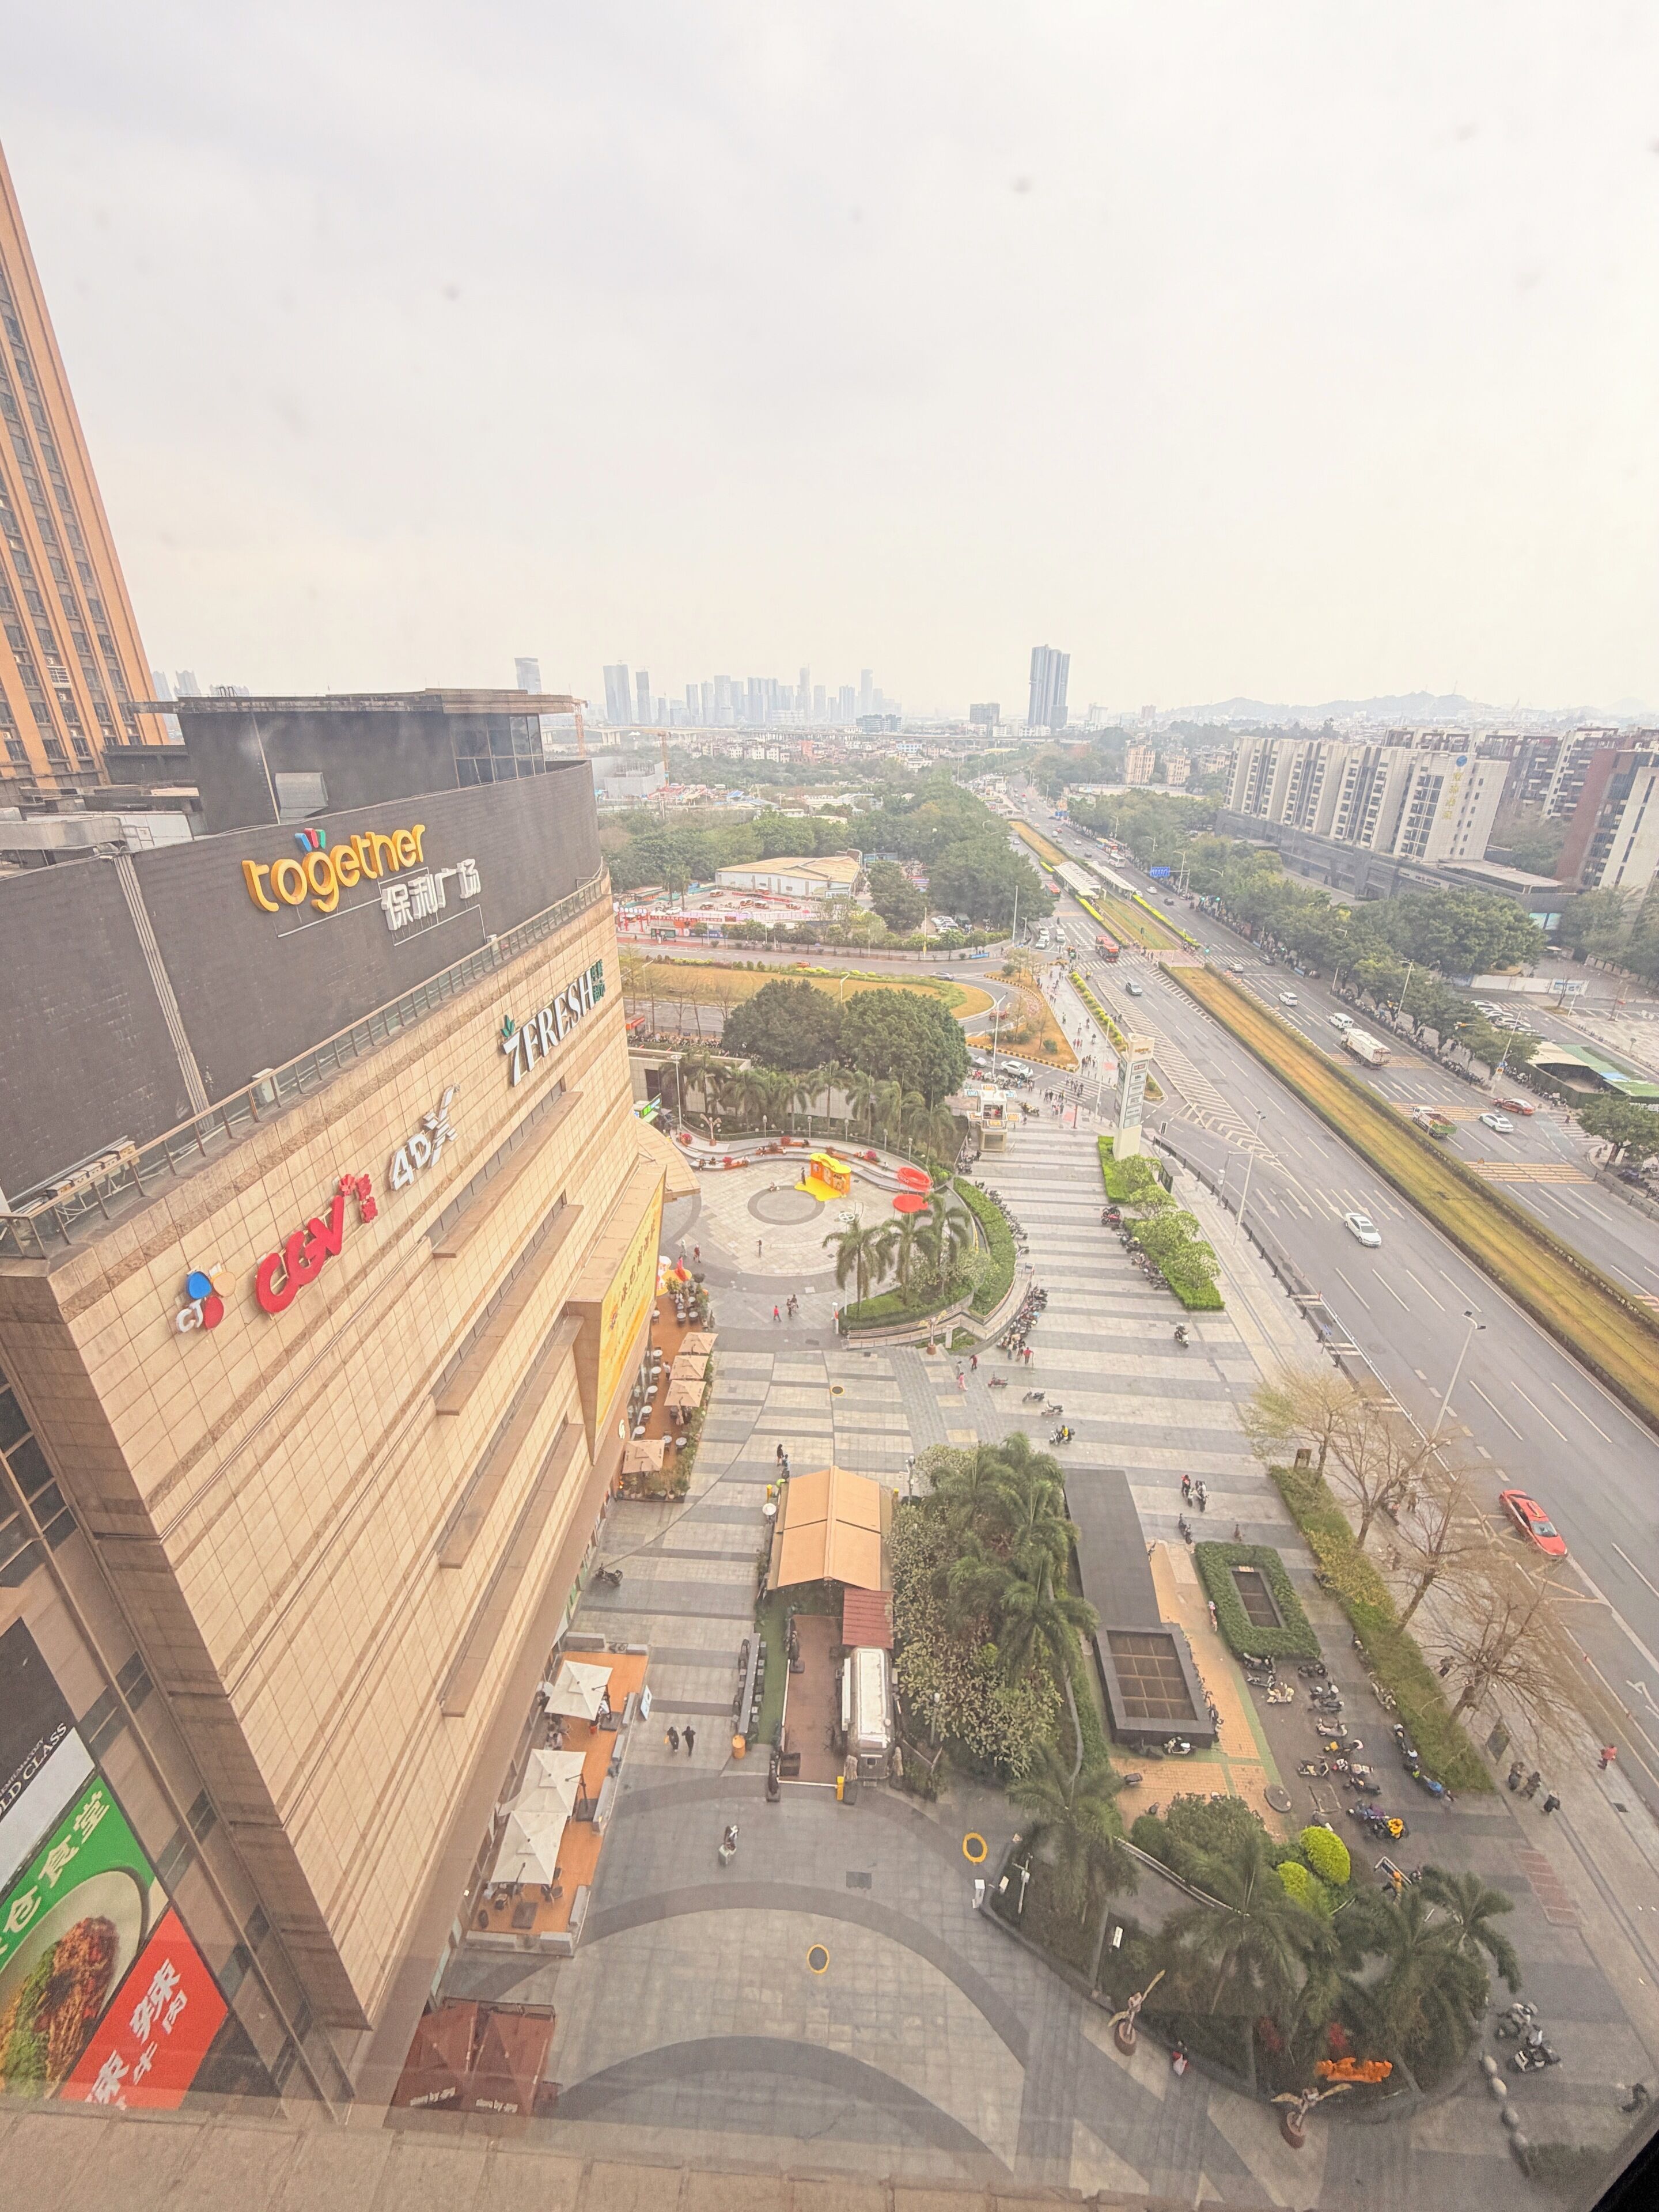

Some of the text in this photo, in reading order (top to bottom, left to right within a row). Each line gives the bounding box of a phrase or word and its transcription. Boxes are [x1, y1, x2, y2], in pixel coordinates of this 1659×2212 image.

[242, 824, 425, 912] together
[381, 858, 480, 930] 保利广场
[502, 967, 595, 1087] 7FRESH
[256, 1195, 344, 1313] CGV
[23, 1722, 66, 1780] CLASS
[0, 1790, 111, 1956] 仓食堂
